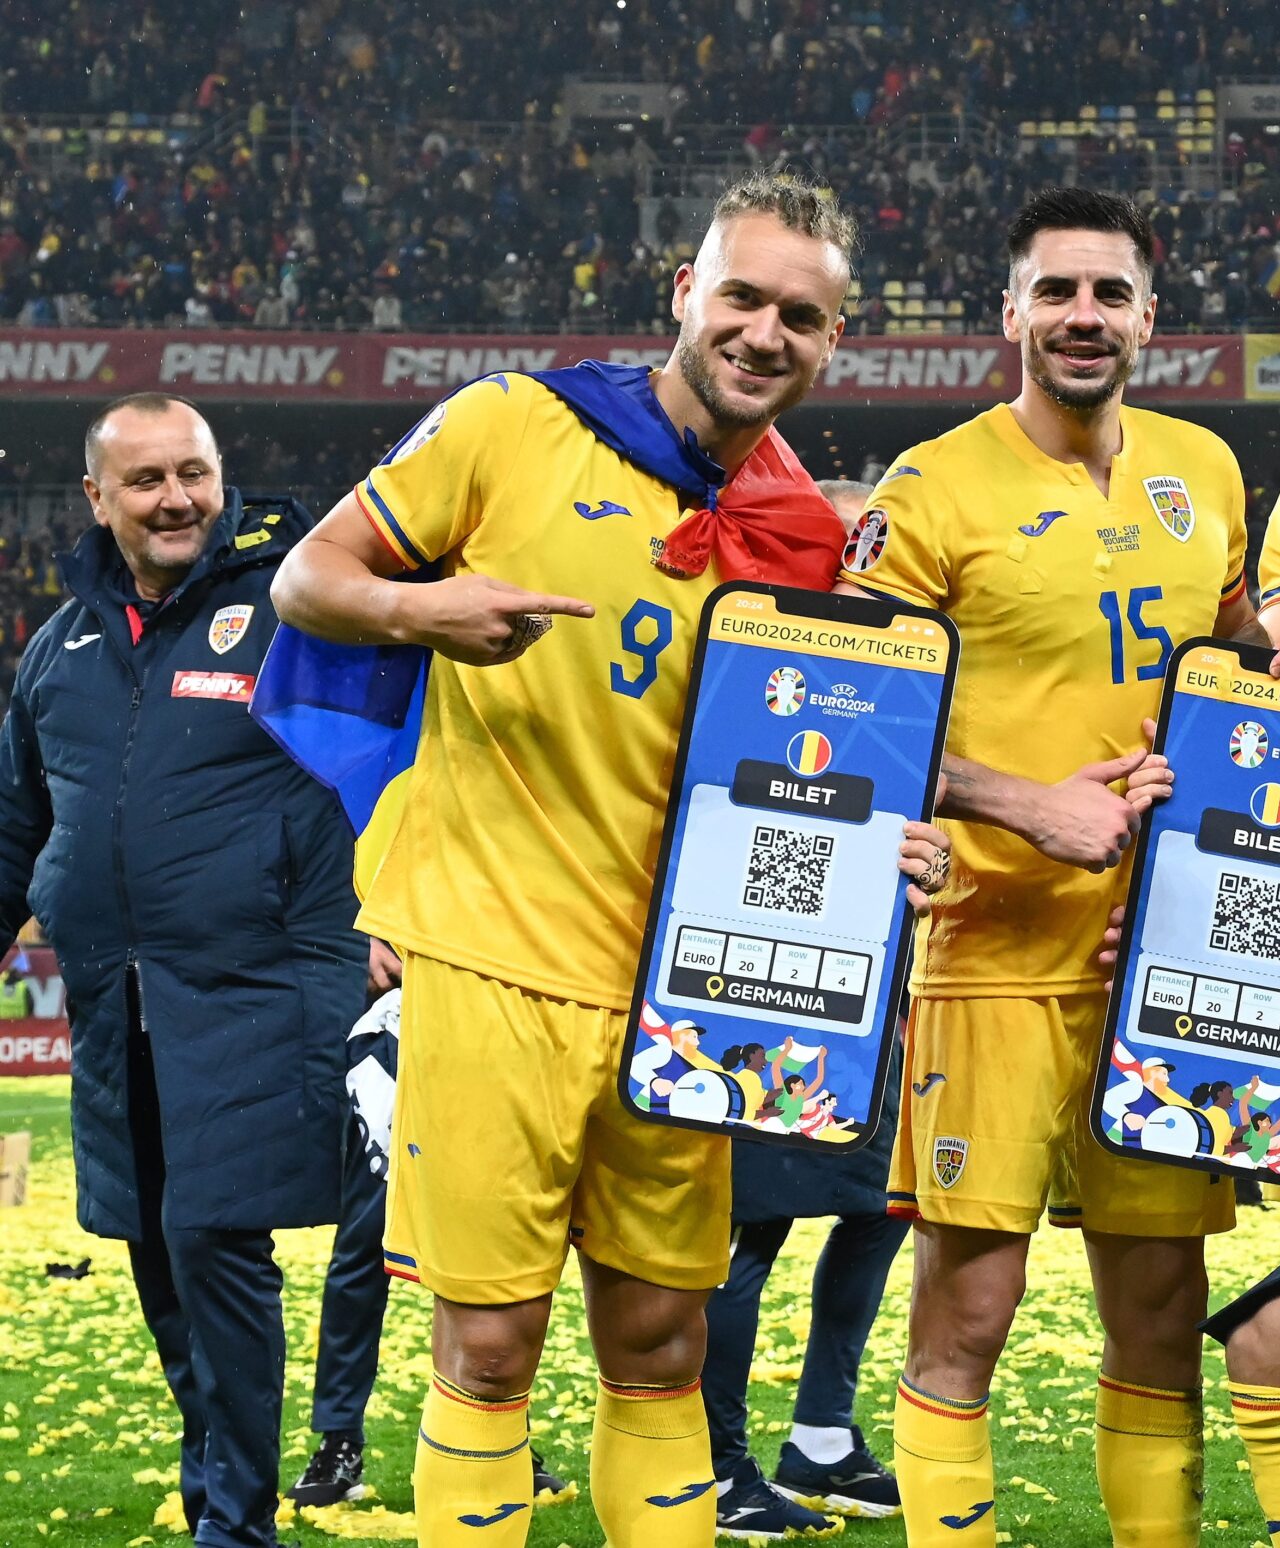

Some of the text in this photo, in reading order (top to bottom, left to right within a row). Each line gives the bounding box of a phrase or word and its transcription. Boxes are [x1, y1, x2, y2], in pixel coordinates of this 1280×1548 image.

[1147, 477, 1183, 491] ROMÂNIA
[1096, 527, 1117, 539] ROU
[735, 598, 764, 612] 20:24
[720, 617, 938, 663] EURO2024.COM/TICKETS
[1098, 585, 1176, 685] 15
[609, 597, 673, 700] 9
[831, 685, 856, 698] UEFA
[809, 693, 876, 714] EURO2024
[822, 707, 859, 719] GERMANY
[768, 779, 837, 806] BILET
[682, 933, 724, 947] ENTRANCE
[737, 942, 763, 953] BLOCK
[683, 952, 715, 966] EURO
[788, 950, 808, 960] ROW
[738, 960, 755, 973] 20
[836, 958, 856, 968] SEAT
[790, 968, 799, 979] 2
[837, 976, 846, 987] 4
[1151, 974, 1192, 988] ENTRANCE
[1204, 984, 1230, 995] BLOCK
[727, 982, 826, 1013] GERMANIA
[1152, 991, 1184, 1006] EURO
[1253, 993, 1273, 1003] ROW
[1206, 1001, 1222, 1013] 20
[1255, 1010, 1264, 1021] 2
[937, 1138, 966, 1152] ROMÂNIA
